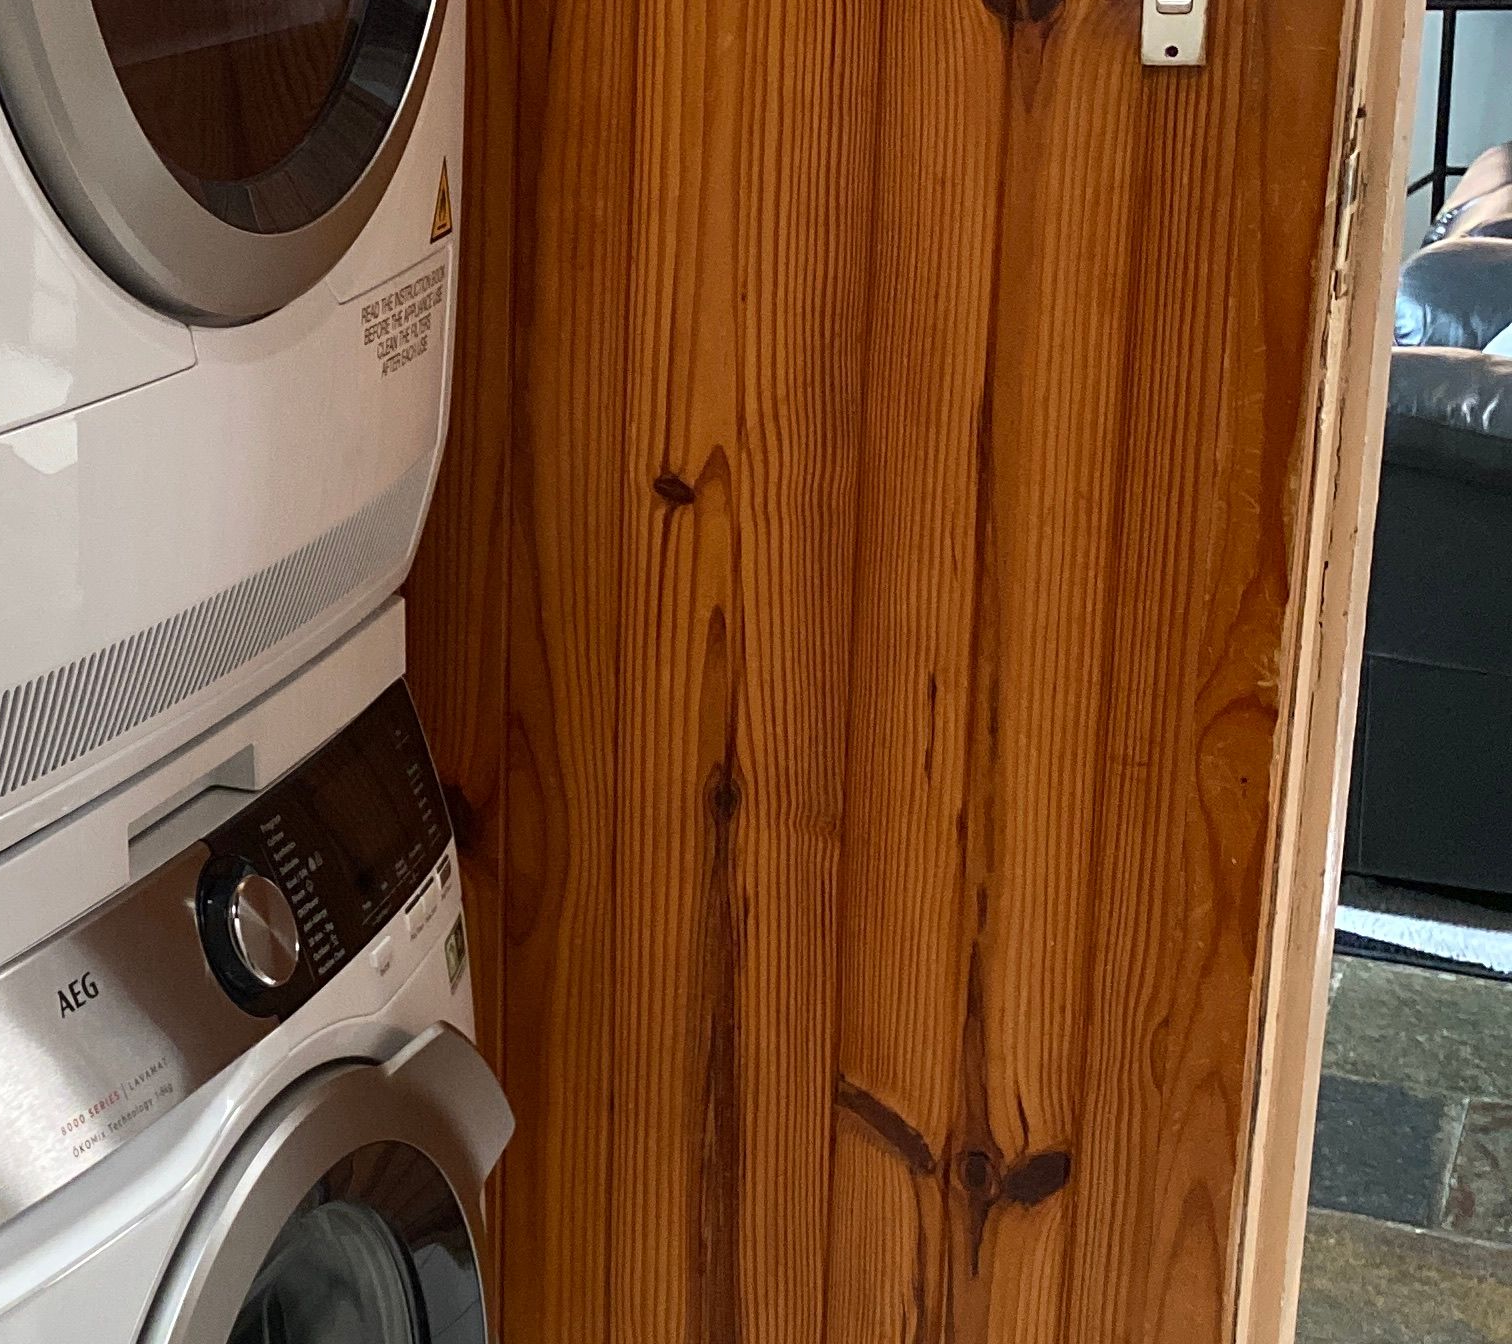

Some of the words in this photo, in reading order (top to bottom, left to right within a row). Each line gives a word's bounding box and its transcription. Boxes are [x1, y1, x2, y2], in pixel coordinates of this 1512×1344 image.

[364, 317, 390, 345] BEFORE
[377, 335, 398, 359] CLEAN
[57, 971, 100, 1019] AEG
[60, 1113, 86, 1137] 8000
[87, 1089, 121, 1120] SERIES
[128, 1057, 167, 1092] LAVAMAT
[72, 1130, 106, 1159] ÖKOMix
[107, 1098, 154, 1133] Technology
